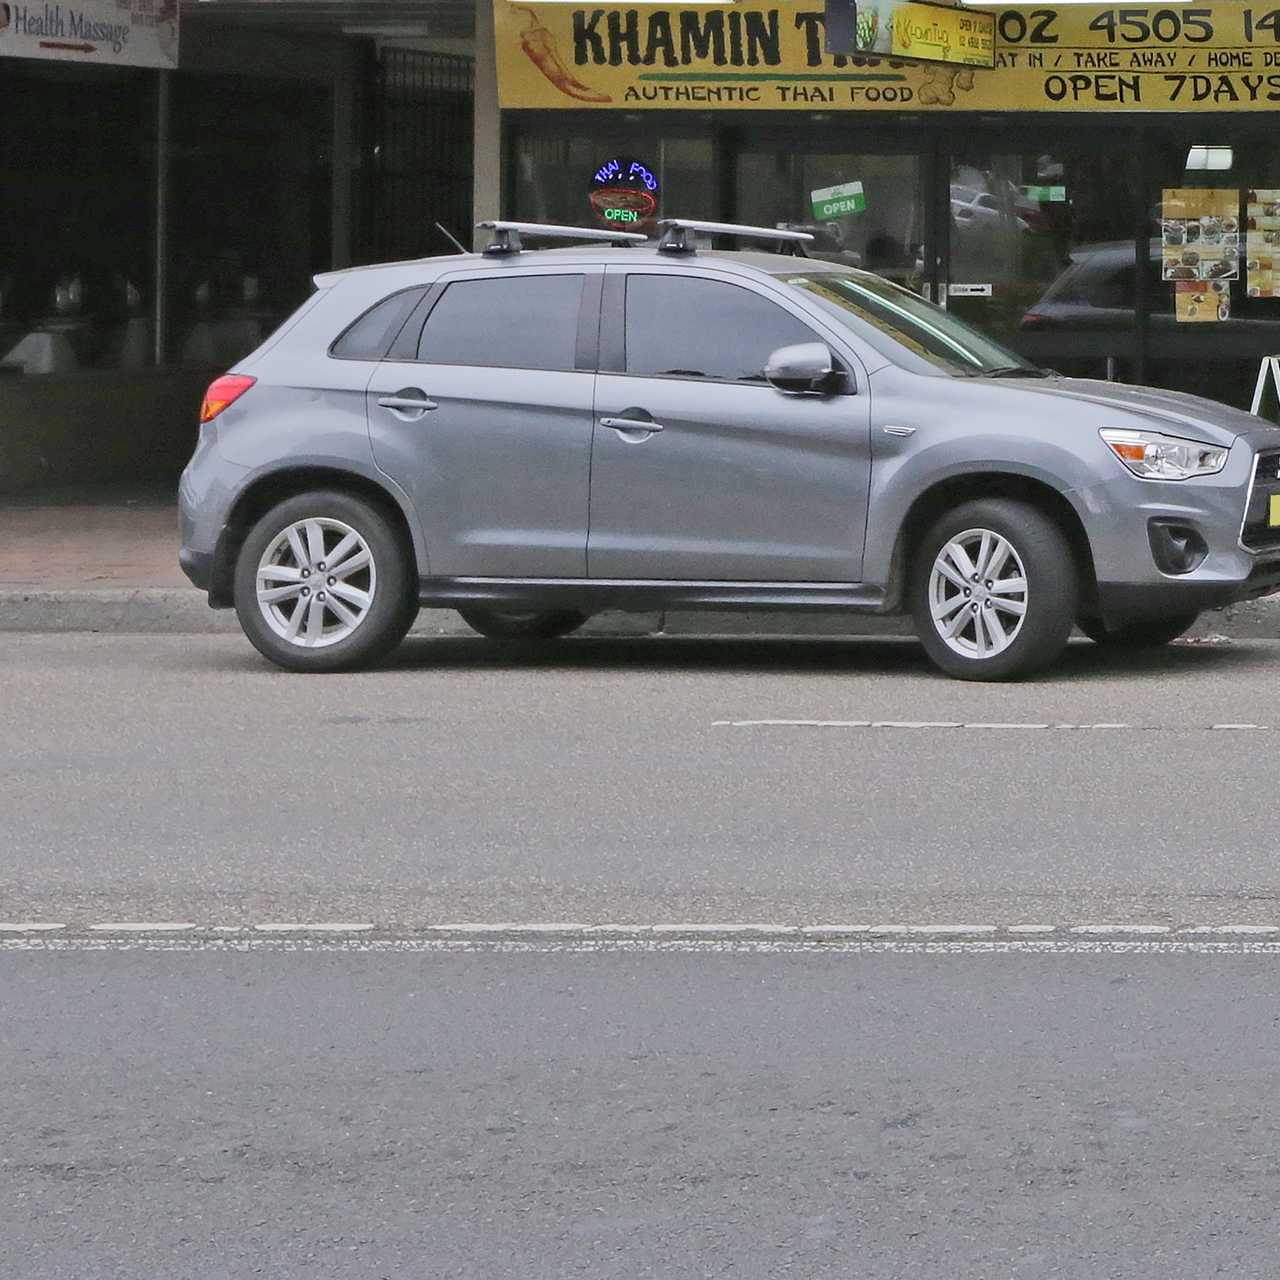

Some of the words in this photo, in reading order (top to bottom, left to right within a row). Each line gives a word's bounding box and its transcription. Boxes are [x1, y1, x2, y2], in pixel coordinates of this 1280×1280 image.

[15, 3, 64, 37] Health
[69, 8, 130, 54] Massage
[572, 9, 782, 68] KHAMIN
[998, 10, 1059, 43] 02
[1089, 9, 1214, 43] 4505
[996, 52, 1018, 68] AT
[1028, 52, 1043, 68] IN
[1073, 52, 1120, 68] TAKE
[1130, 51, 1177, 68] AWAY
[1207, 51, 1252, 68] HOME
[625, 86, 761, 102] AUTHENTIC
[775, 86, 834, 102] THAI
[851, 86, 913, 102] FOOD
[1044, 75, 1141, 103] OPEN
[594, 160, 620, 183] THAI
[629, 162, 657, 190] FOOD
[604, 208, 638, 222] OPEN
[823, 199, 856, 216] OPEN
